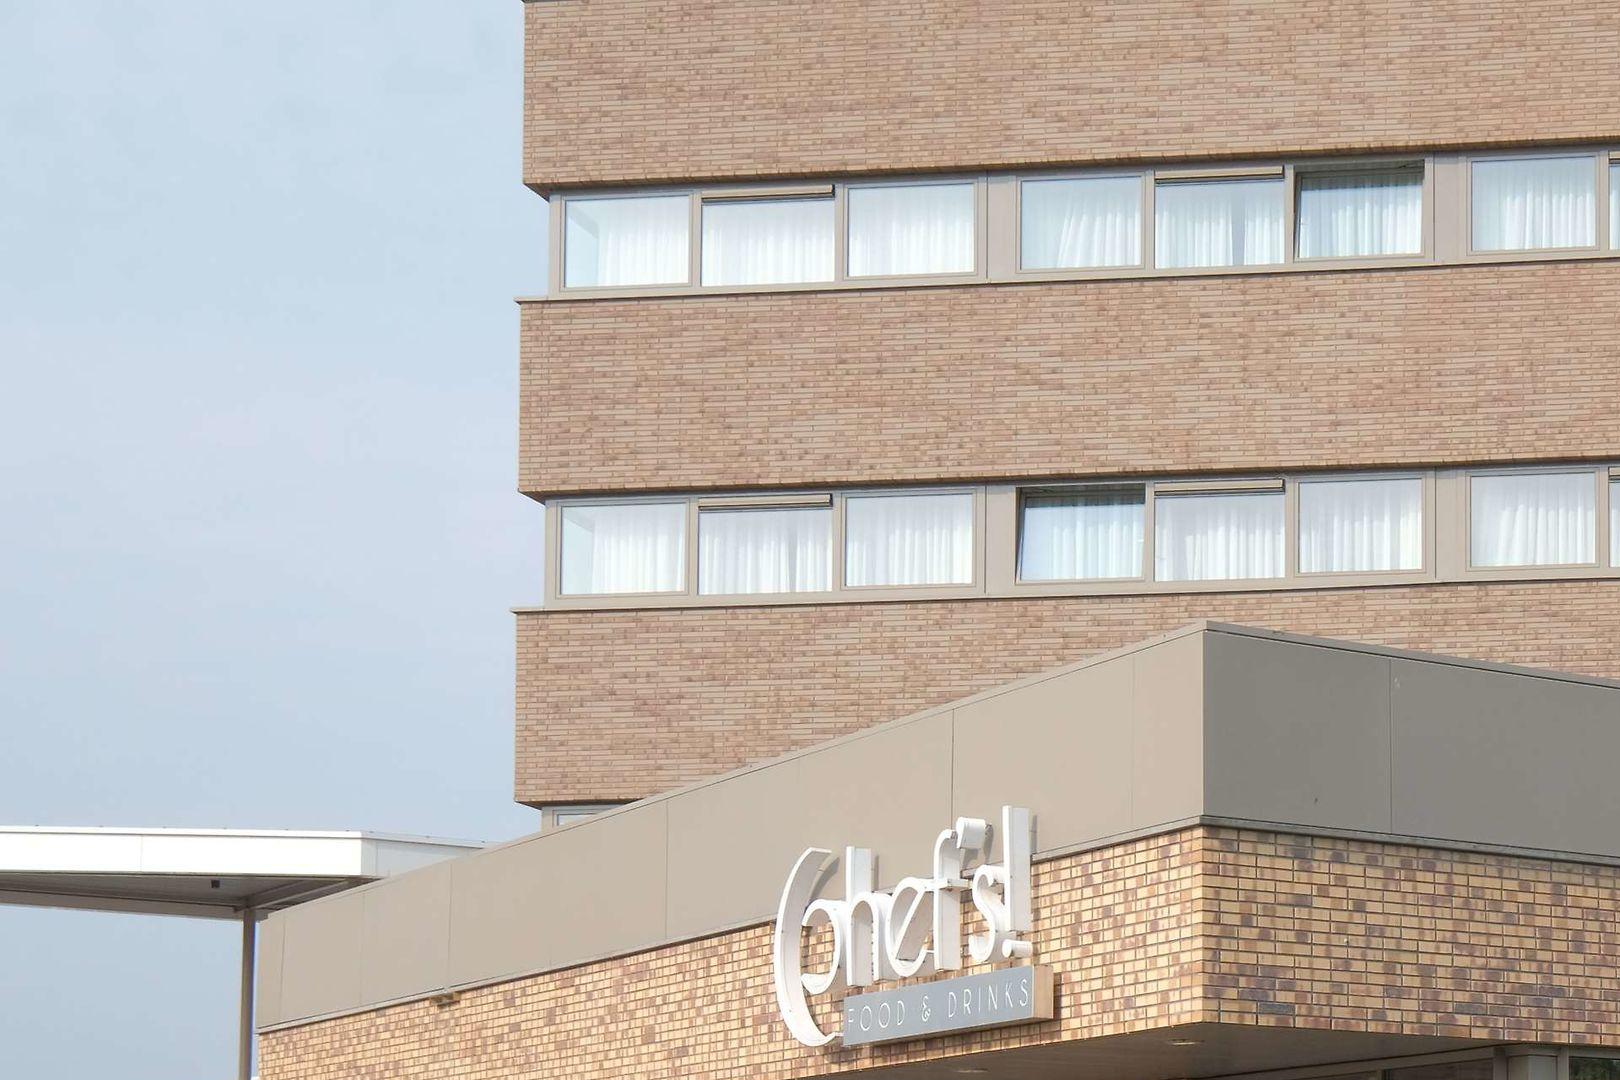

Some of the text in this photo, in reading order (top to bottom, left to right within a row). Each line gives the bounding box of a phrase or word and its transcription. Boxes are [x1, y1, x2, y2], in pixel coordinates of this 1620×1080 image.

[848, 979, 1028, 1032] FOOD & DRINKS
